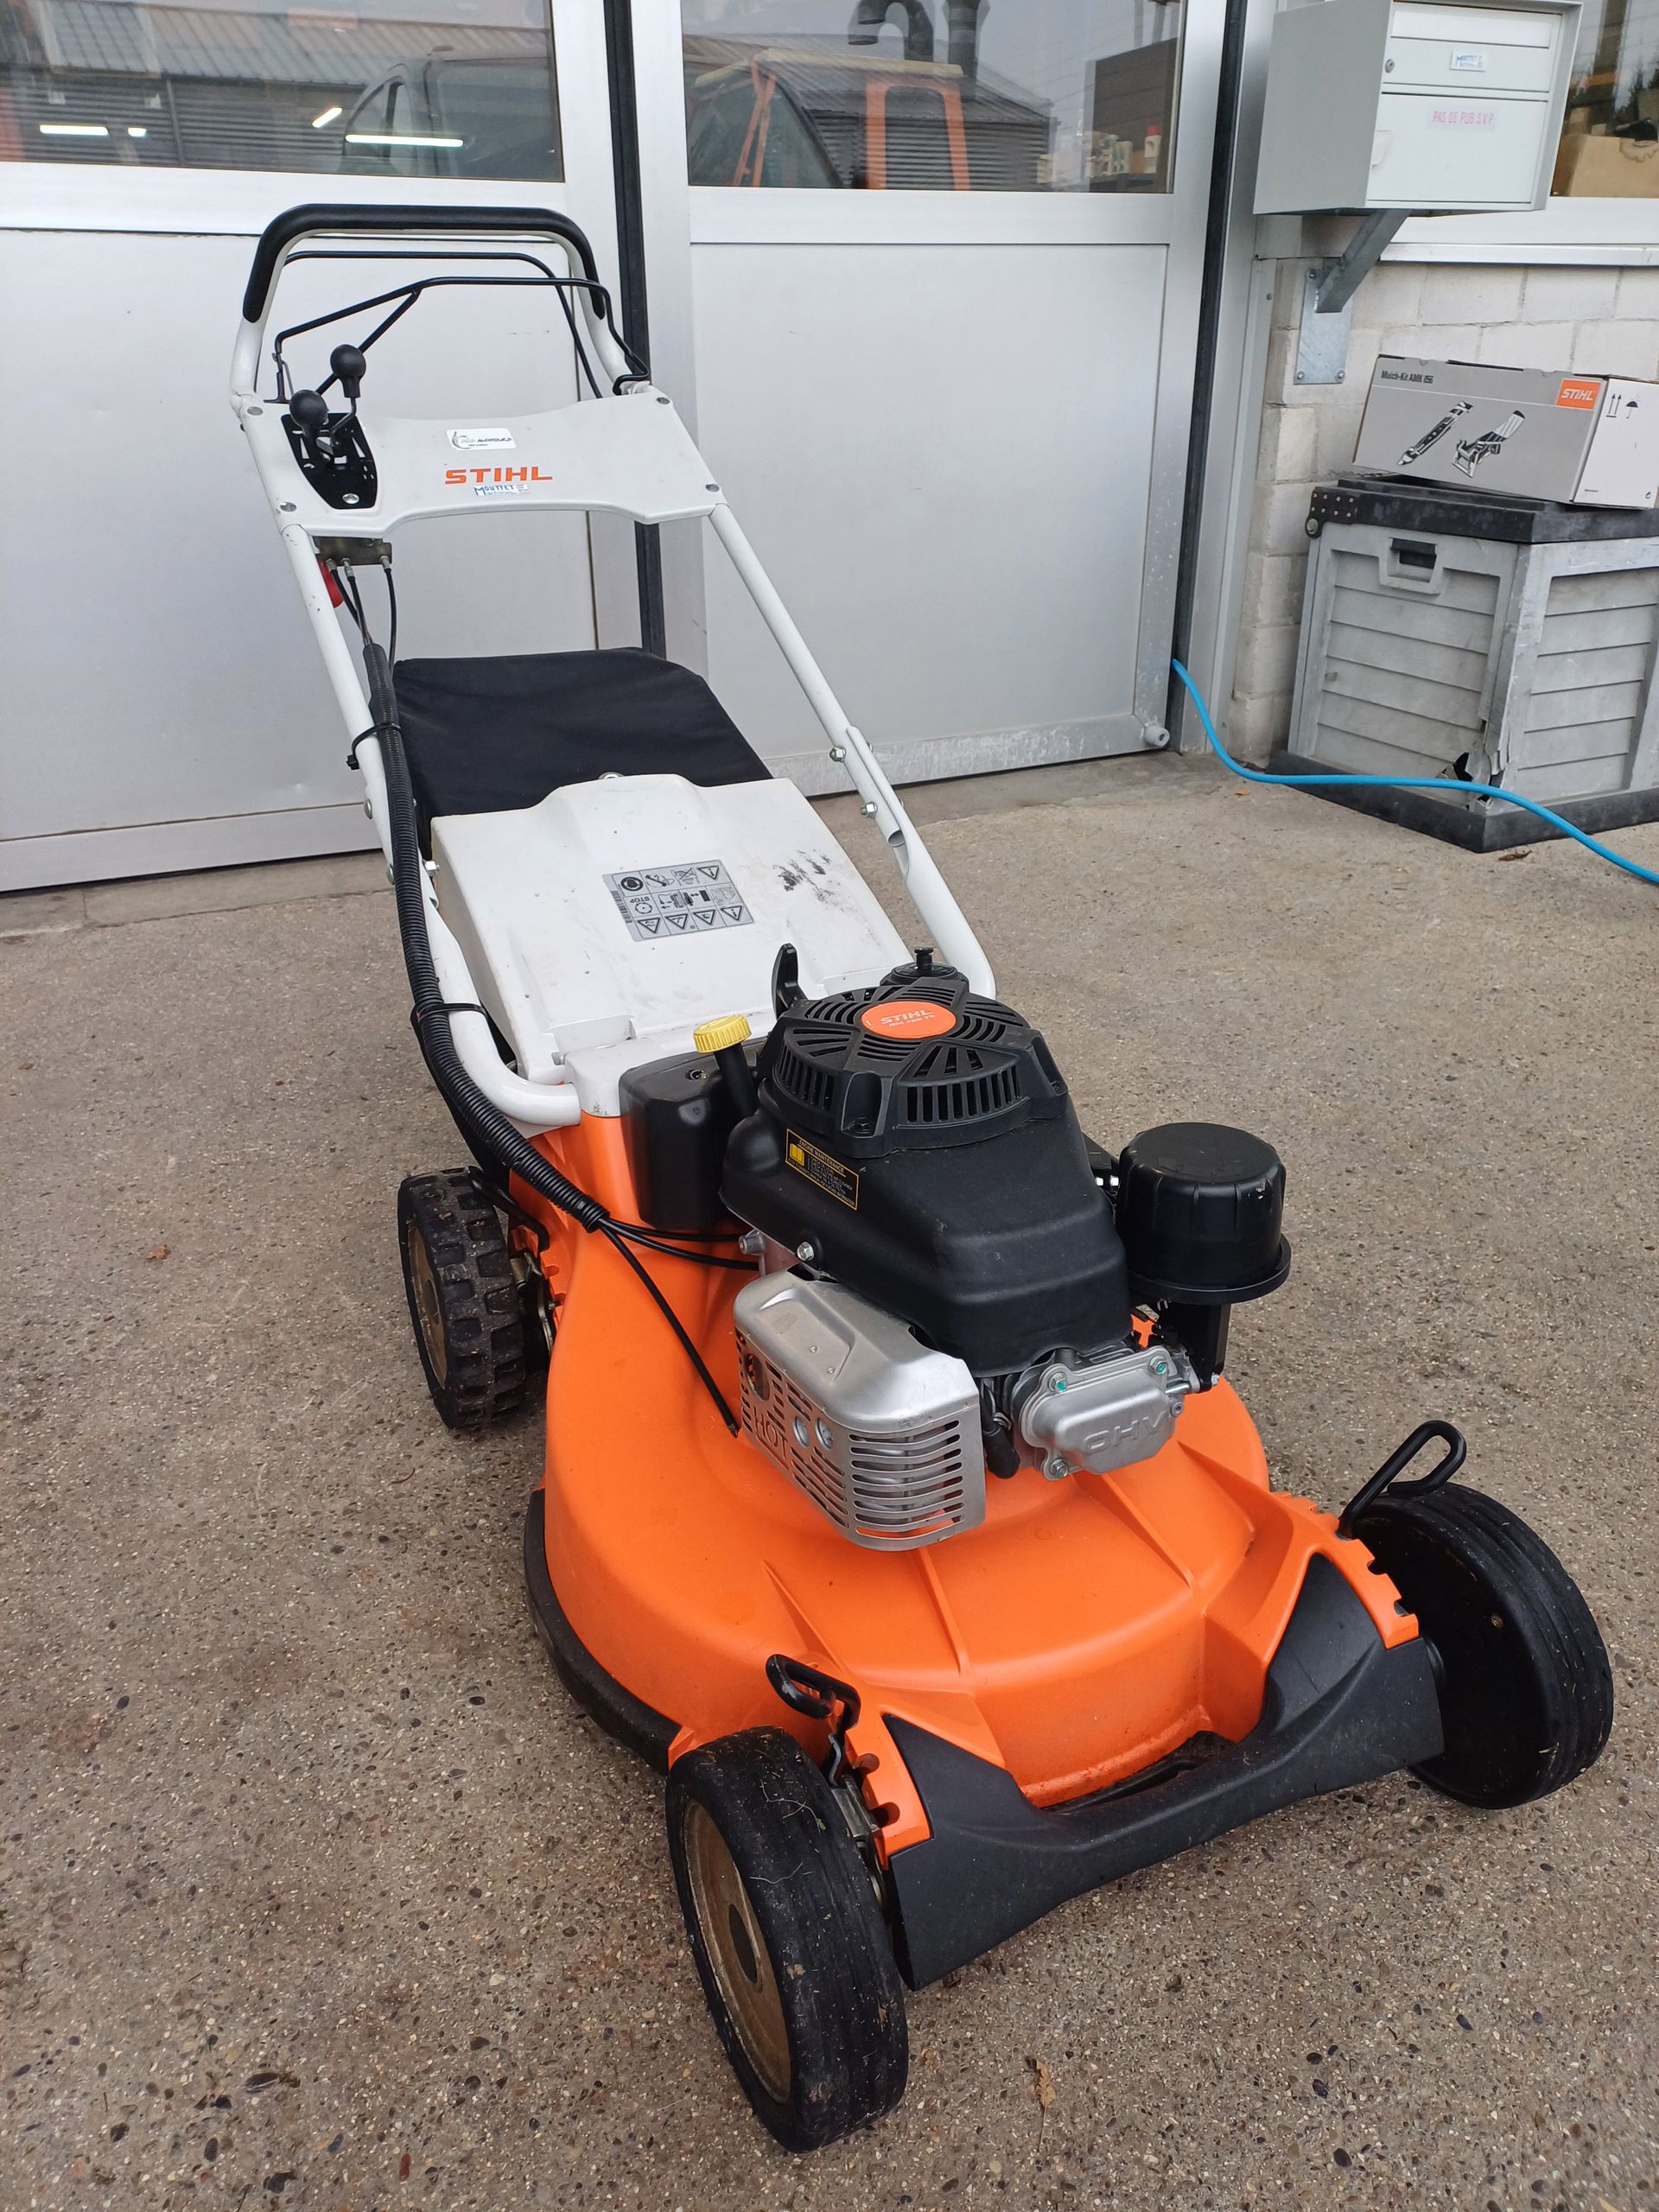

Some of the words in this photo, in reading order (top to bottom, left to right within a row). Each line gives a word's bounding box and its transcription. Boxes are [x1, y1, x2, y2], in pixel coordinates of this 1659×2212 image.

[1560, 388, 1594, 401] STIHL
[444, 466, 553, 485] STIHL
[880, 1008, 933, 1026] STIHL
[753, 1406, 788, 1459] HOT
[1084, 1411, 1166, 1455] OHV
